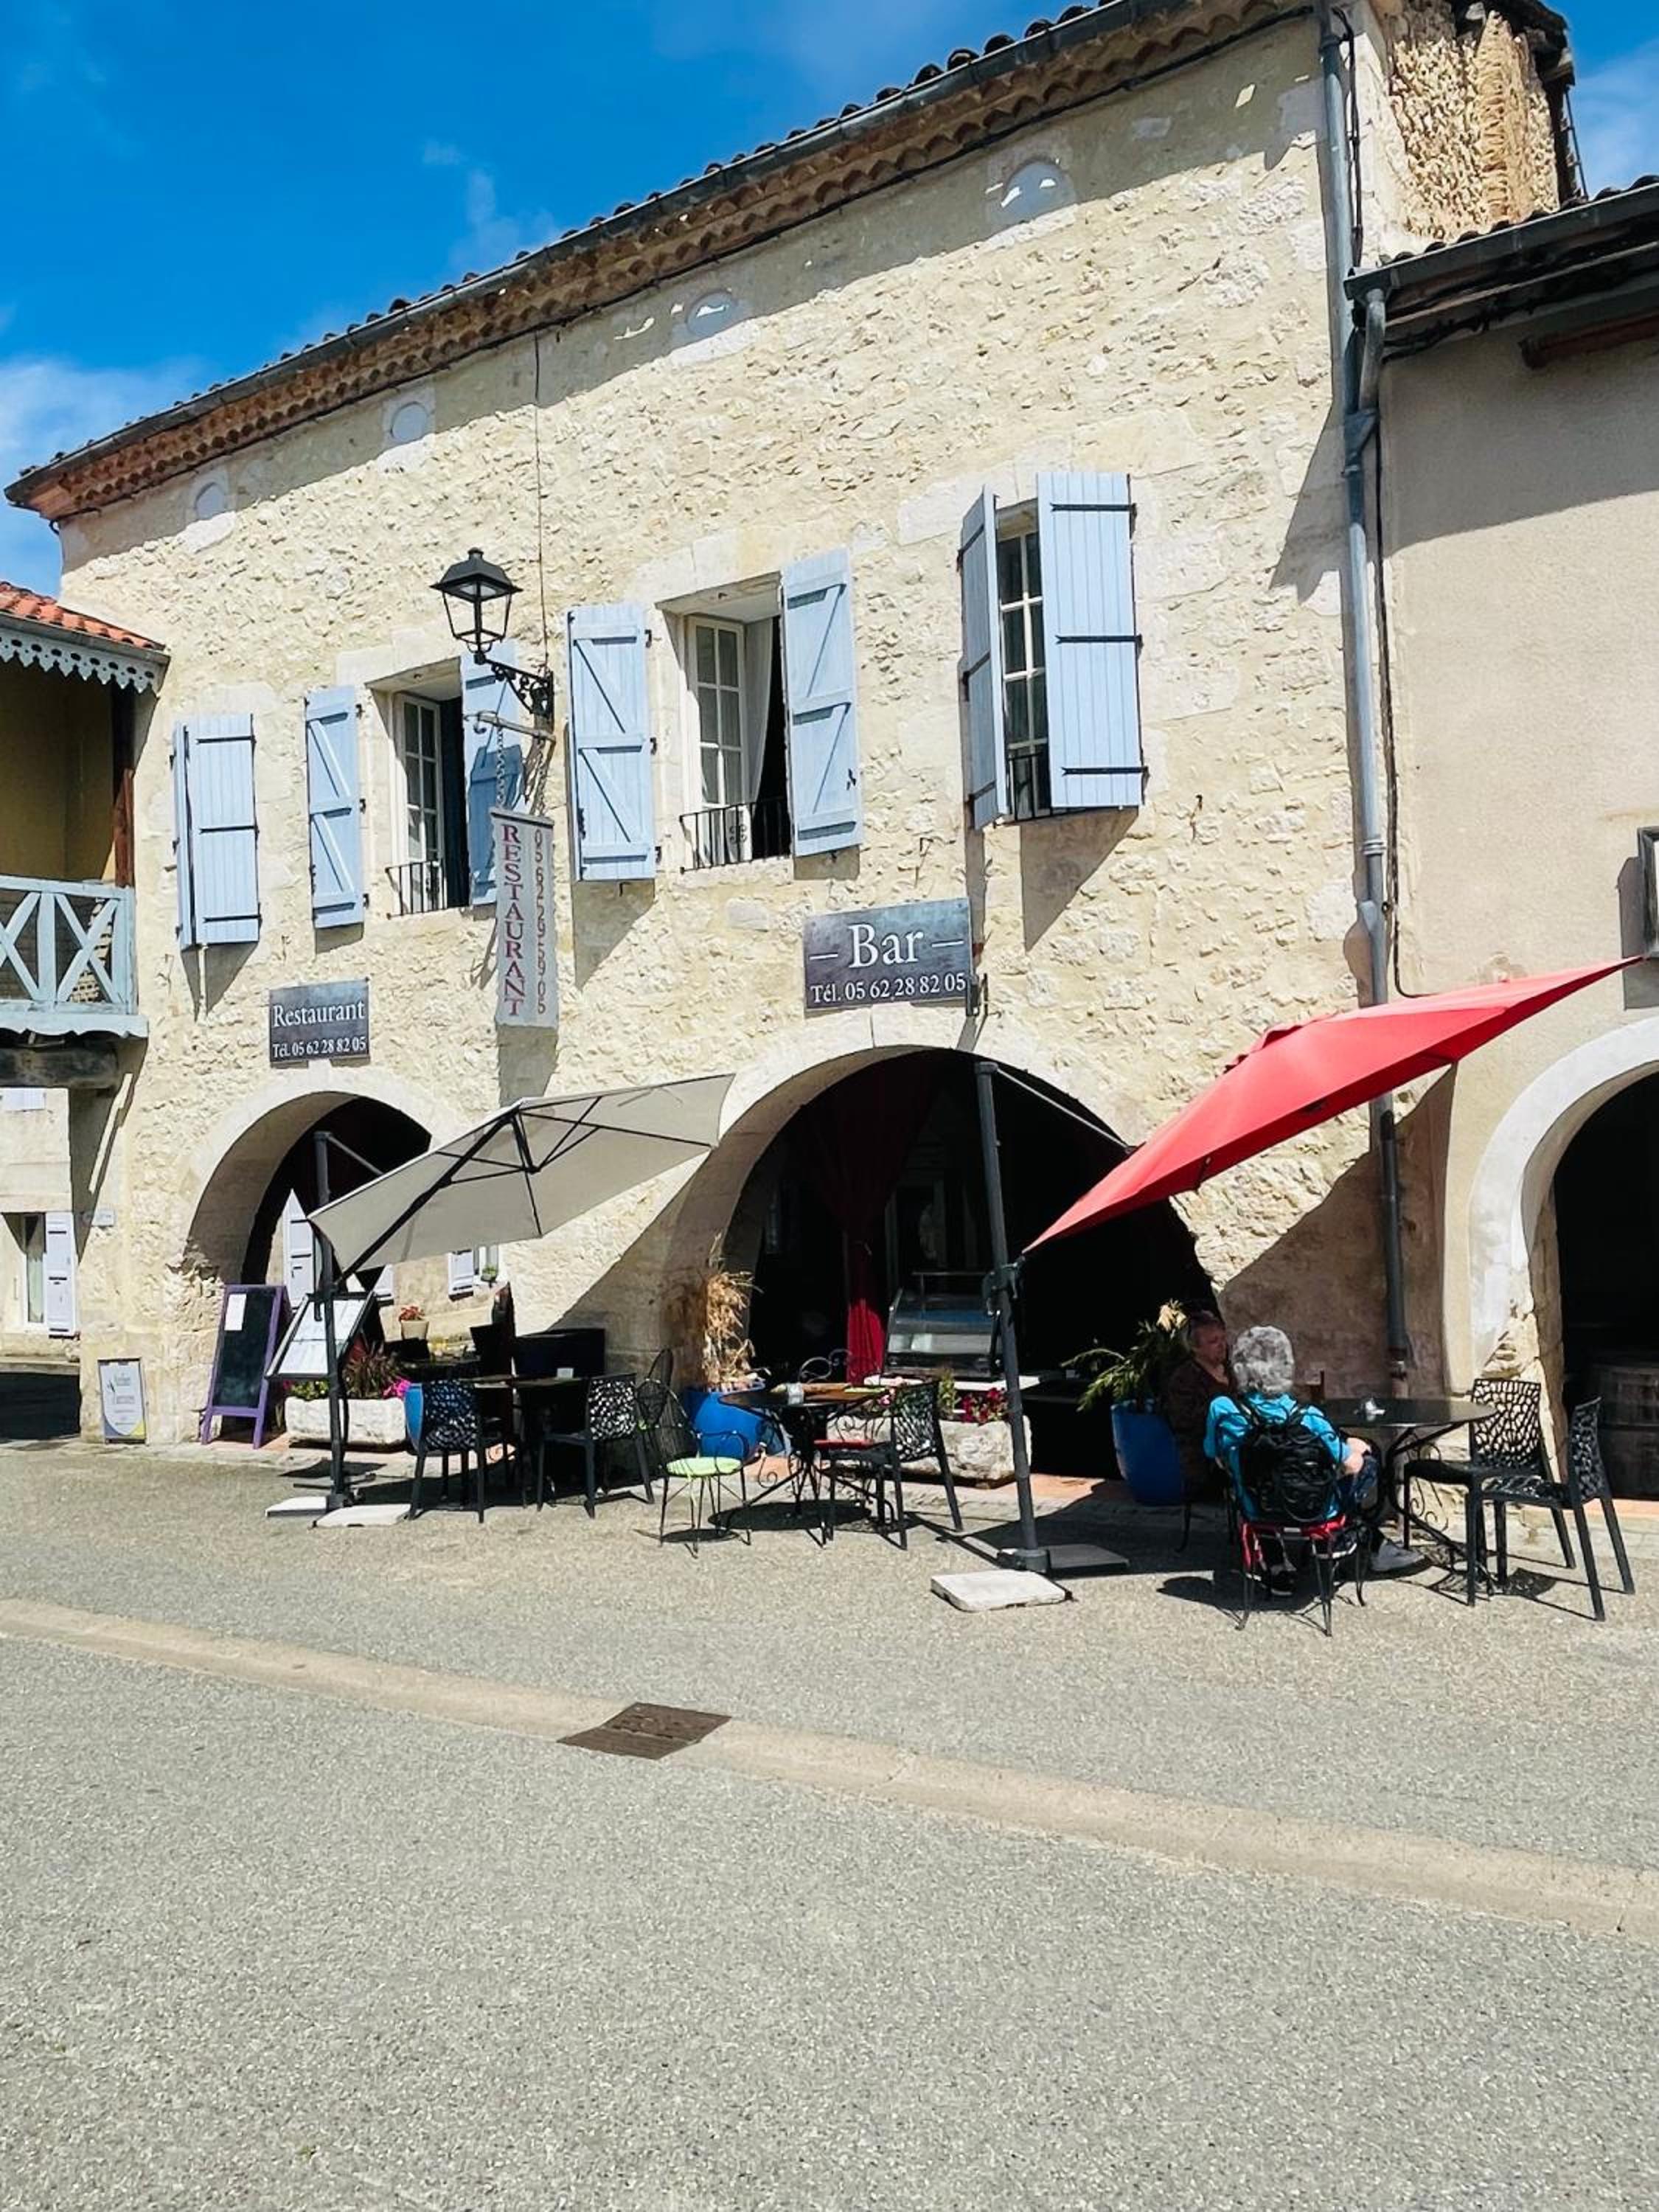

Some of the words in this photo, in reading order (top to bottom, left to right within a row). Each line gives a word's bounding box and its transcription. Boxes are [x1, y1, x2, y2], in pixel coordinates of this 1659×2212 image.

[501, 824, 526, 1016] RESTAURANT
[848, 922, 924, 969] Bar
[810, 982, 841, 1004] Tél.
[844, 981, 866, 1001] 05
[869, 979, 891, 998] 62
[894, 976, 915, 996] 28
[919, 974, 940, 993] 82
[945, 972, 966, 992] 05
[273, 1000, 365, 1027] Restaurant
[292, 1040, 305, 1056] 05
[321, 1039, 335, 1054] 28
[352, 1036, 366, 1051] 05
